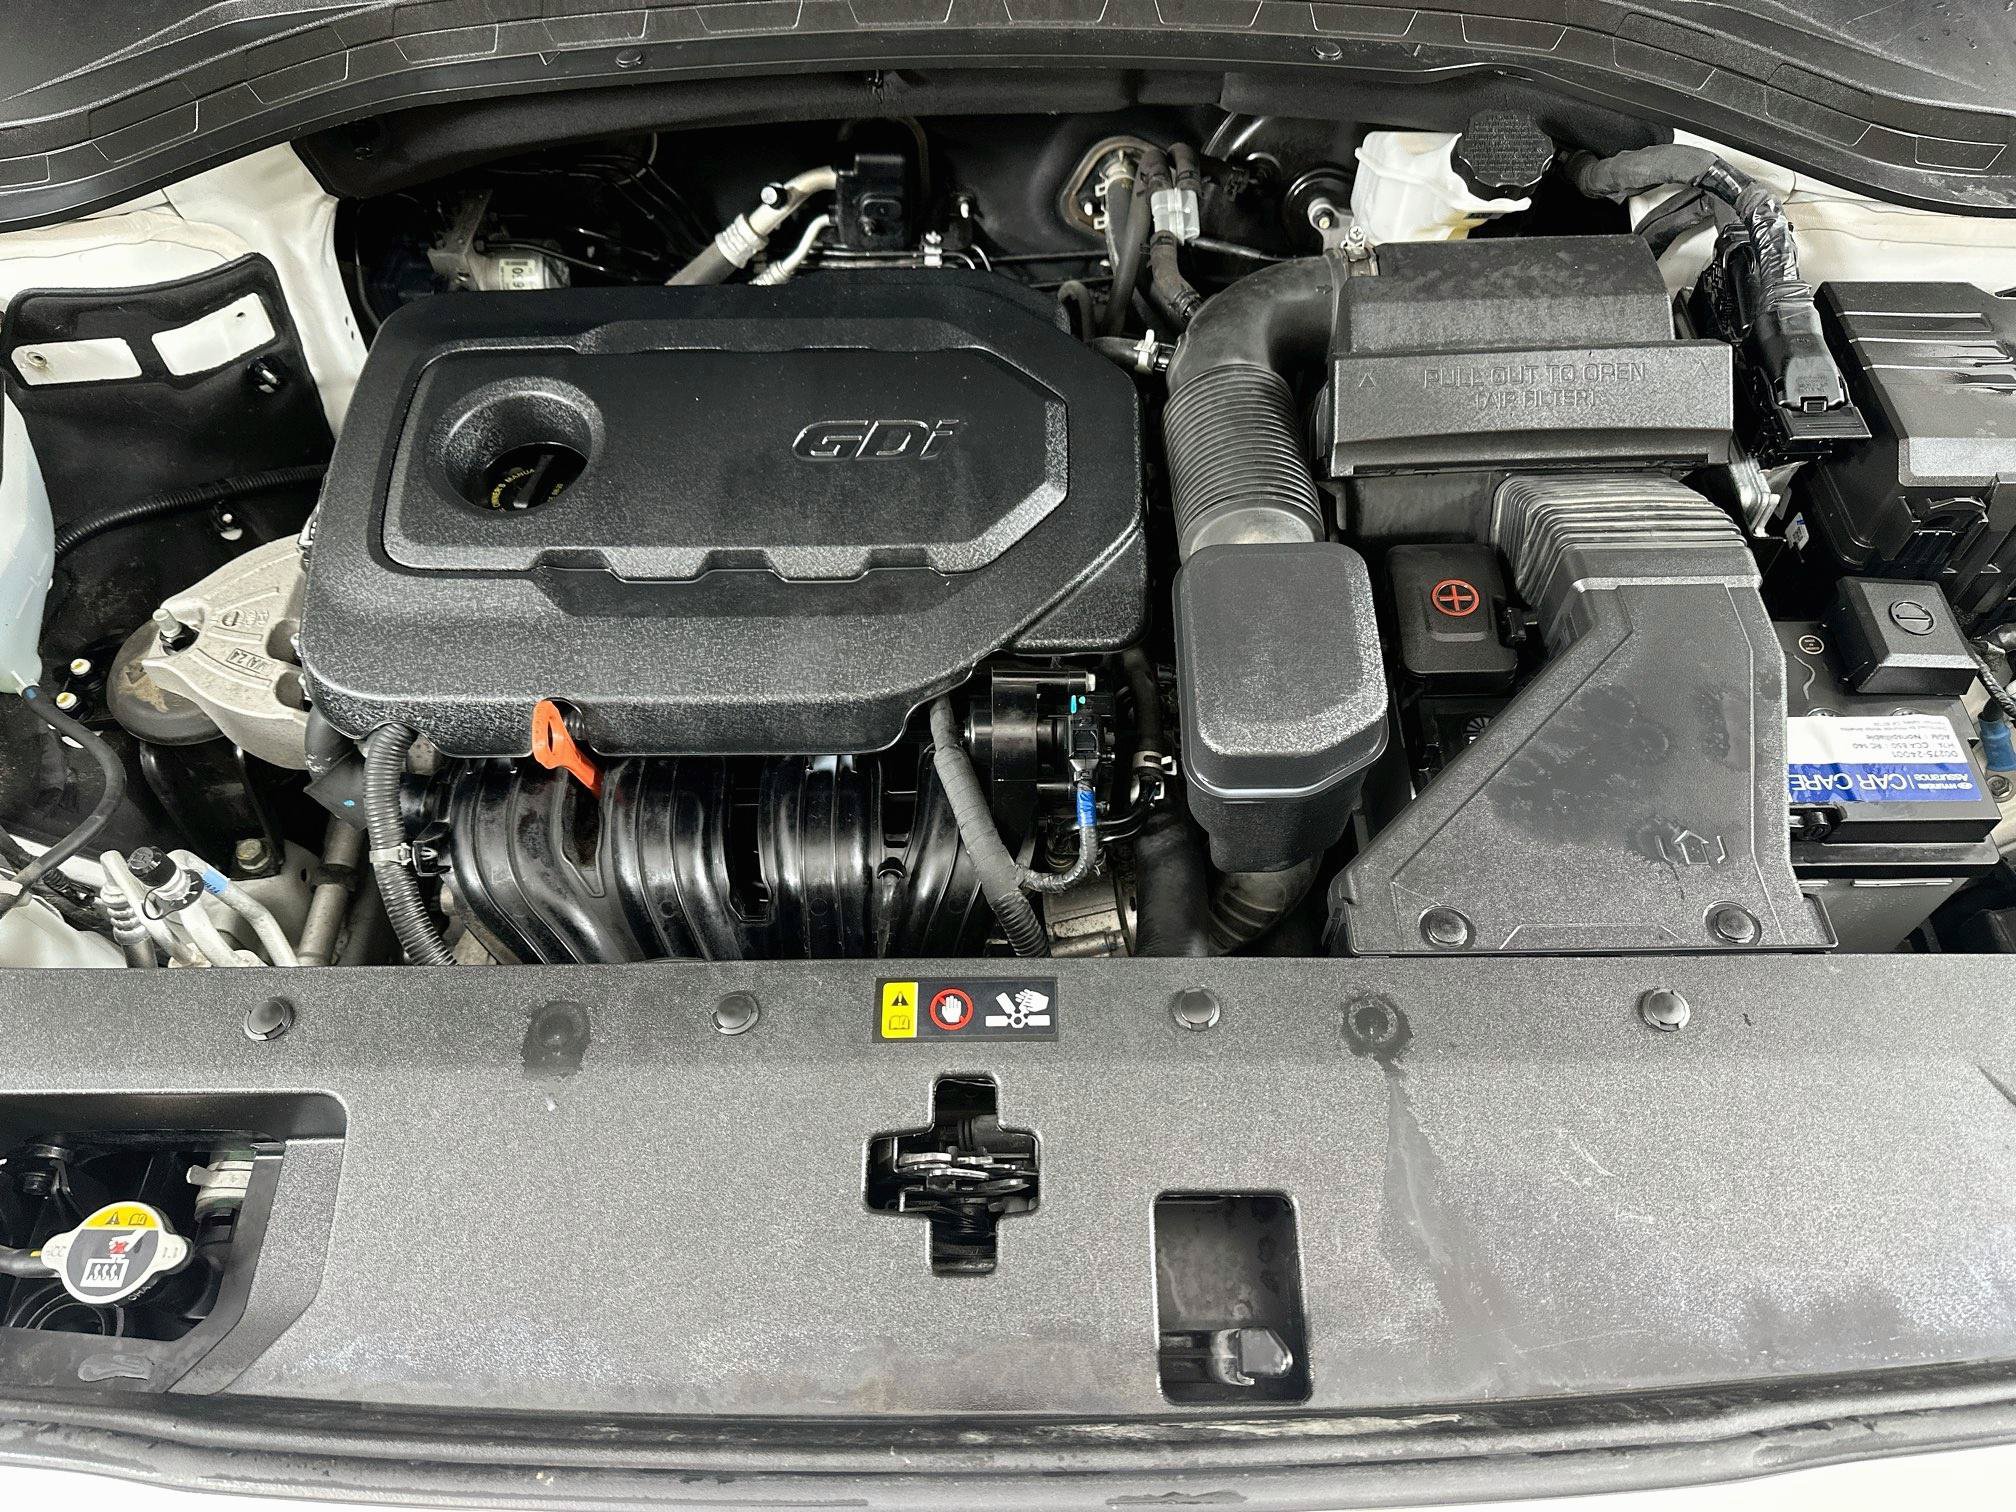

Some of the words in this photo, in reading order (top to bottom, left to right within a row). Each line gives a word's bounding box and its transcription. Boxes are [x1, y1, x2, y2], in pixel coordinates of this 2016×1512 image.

[1424, 368, 1485, 389] PULL
[1490, 364, 1540, 386] OUT
[1545, 363, 1576, 384] TO
[1582, 361, 1646, 383] OPEN
[1788, 773, 1853, 791] CARE
[1856, 773, 1907, 790] CAR
[1913, 773, 1968, 782] Assurance
